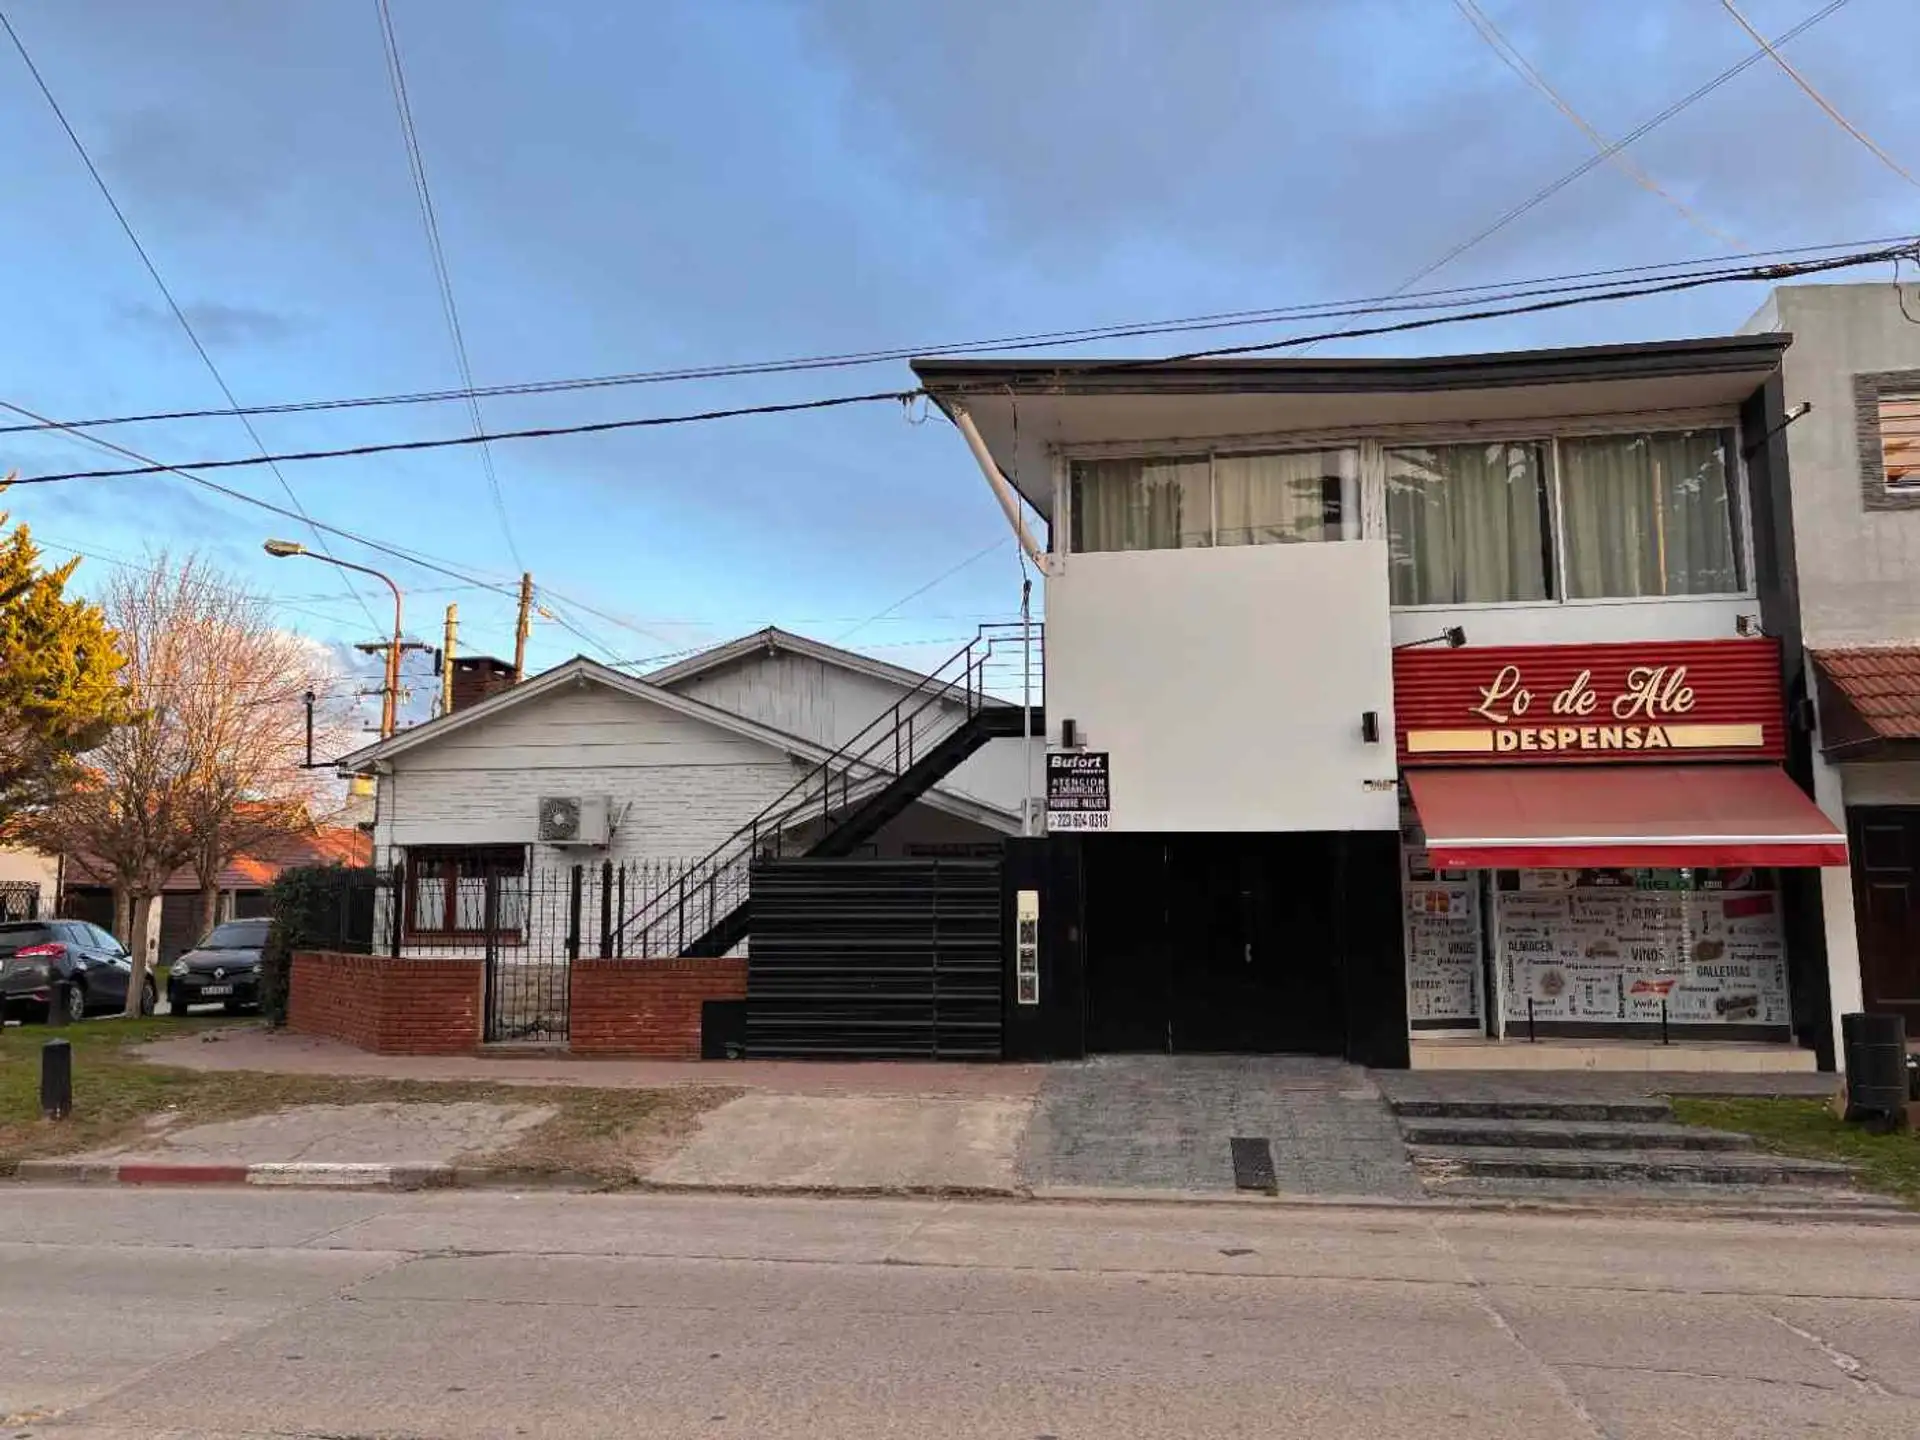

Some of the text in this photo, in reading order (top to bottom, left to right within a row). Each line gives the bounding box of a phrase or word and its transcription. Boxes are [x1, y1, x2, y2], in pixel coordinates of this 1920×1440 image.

[1468, 665, 1696, 723] Lo de Ale
[1496, 726, 1669, 751] DESPENSA
[1051, 755, 1102, 768] Bufort
[1051, 777, 1105, 787] ATENCION
